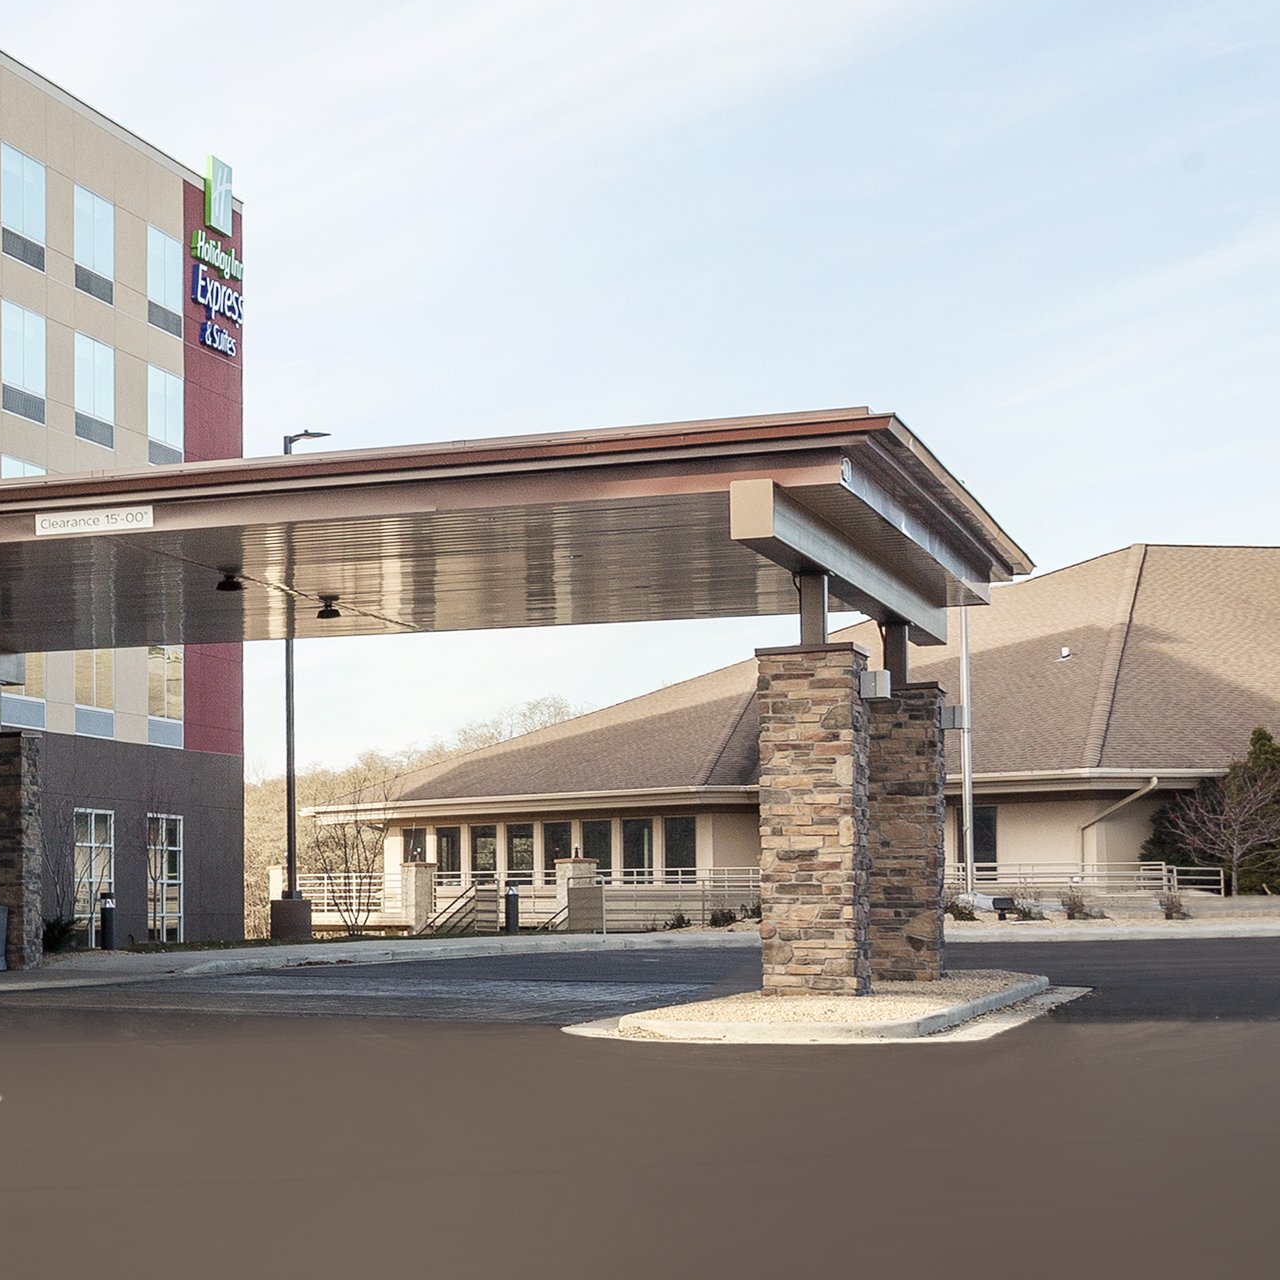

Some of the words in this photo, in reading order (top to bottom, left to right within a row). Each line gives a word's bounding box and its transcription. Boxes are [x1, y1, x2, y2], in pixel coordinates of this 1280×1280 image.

[195, 230, 231, 279] Holiday
[196, 263, 245, 325] Express
[205, 321, 213, 346] &
[211, 324, 237, 357] Suites
[40, 517, 100, 530] Clearance
